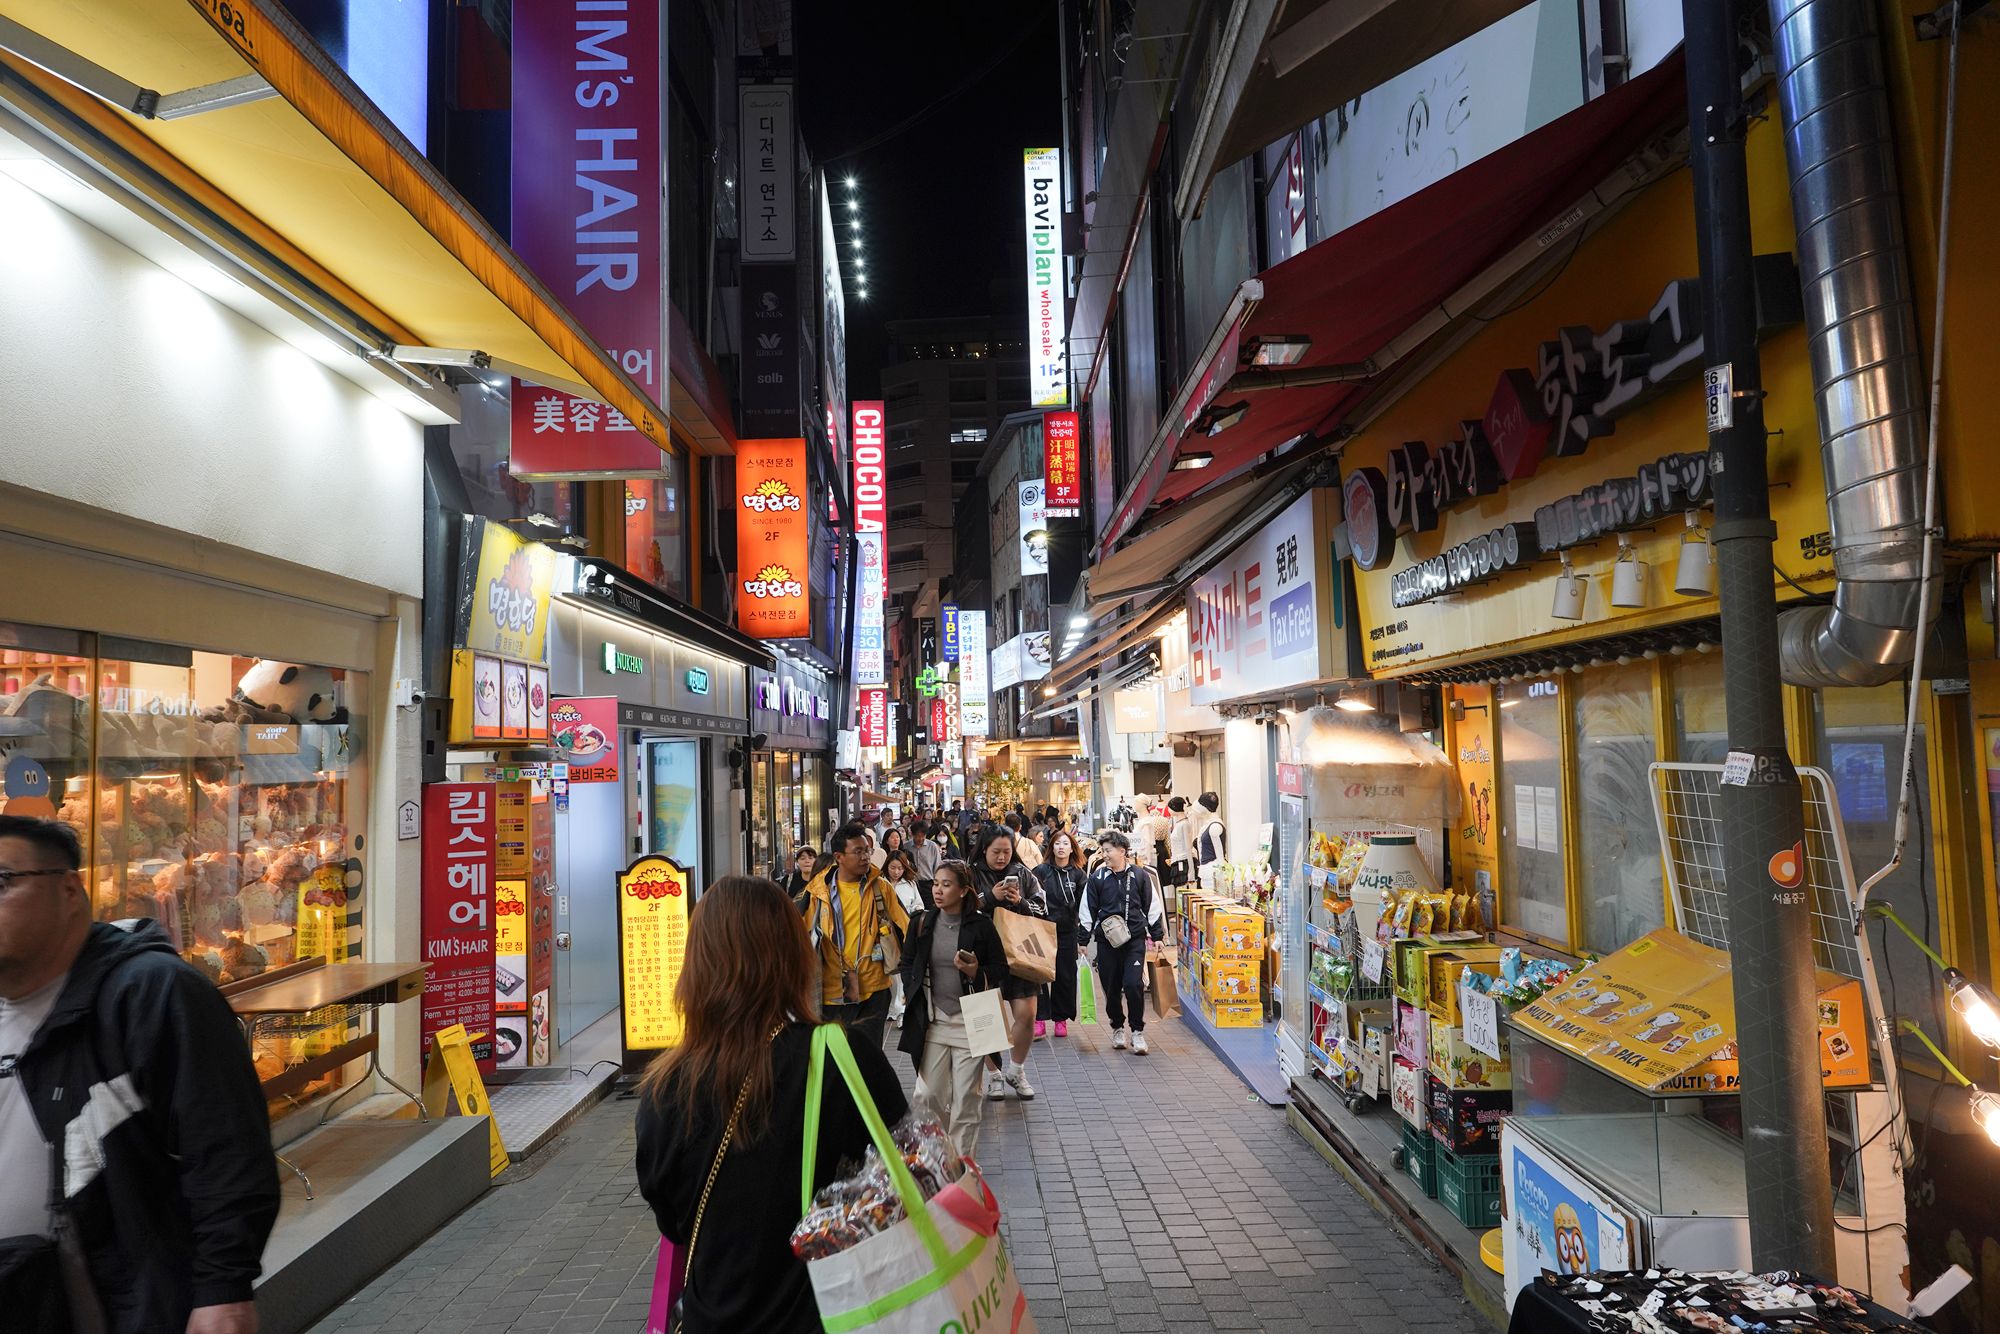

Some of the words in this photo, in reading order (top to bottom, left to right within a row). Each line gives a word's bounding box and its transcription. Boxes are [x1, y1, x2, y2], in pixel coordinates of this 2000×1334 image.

[759, 116, 776, 173] 디저트
[575, 128, 639, 296] HAIR
[759, 183, 778, 241] 연구소
[1033, 178, 1056, 286] baviplan
[1041, 289, 1052, 357] wholesale
[1040, 364, 1056, 376] 1F
[533, 396, 637, 434] 美容室
[1049, 428, 1074, 437] 한증막
[746, 458, 794, 468] 스낵전문점
[1057, 487, 1071, 496] 3F
[765, 531, 780, 542] 2F
[1448, 523, 1519, 588] HOTDOG
[749, 609, 797, 620] 스낵전문점
[946, 611, 956, 644] TBC
[1271, 609, 1289, 646] Tax
[1288, 601, 1312, 643] Free
[872, 652, 879, 660] &
[615, 655, 644, 674] NUKHAN
[870, 690, 884, 746] CHOCOLATE
[521, 769, 538, 777] VISA
[570, 767, 617, 781] 냄비국수
[1363, 784, 1405, 798] 빙그레
[404, 808, 413, 822] 32
[448, 791, 487, 931] 킴스헤어
[1394, 873, 1418, 889] 우유
[1771, 892, 1806, 904] 서울중구
[648, 902, 661, 912] 2F
[428, 937, 460, 958] KIM'S
[461, 939, 489, 955] HAIR
[424, 971, 436, 980] Cut
[424, 983, 442, 993] Color
[424, 1011, 442, 1019] Perm
[1524, 1005, 1555, 1024] MULTI
[1557, 1021, 1586, 1039] PACK
[1613, 1048, 1649, 1068] PACK
[1661, 1075, 1703, 1090] MULTI
[1518, 1160, 1550, 1213] Pororo
